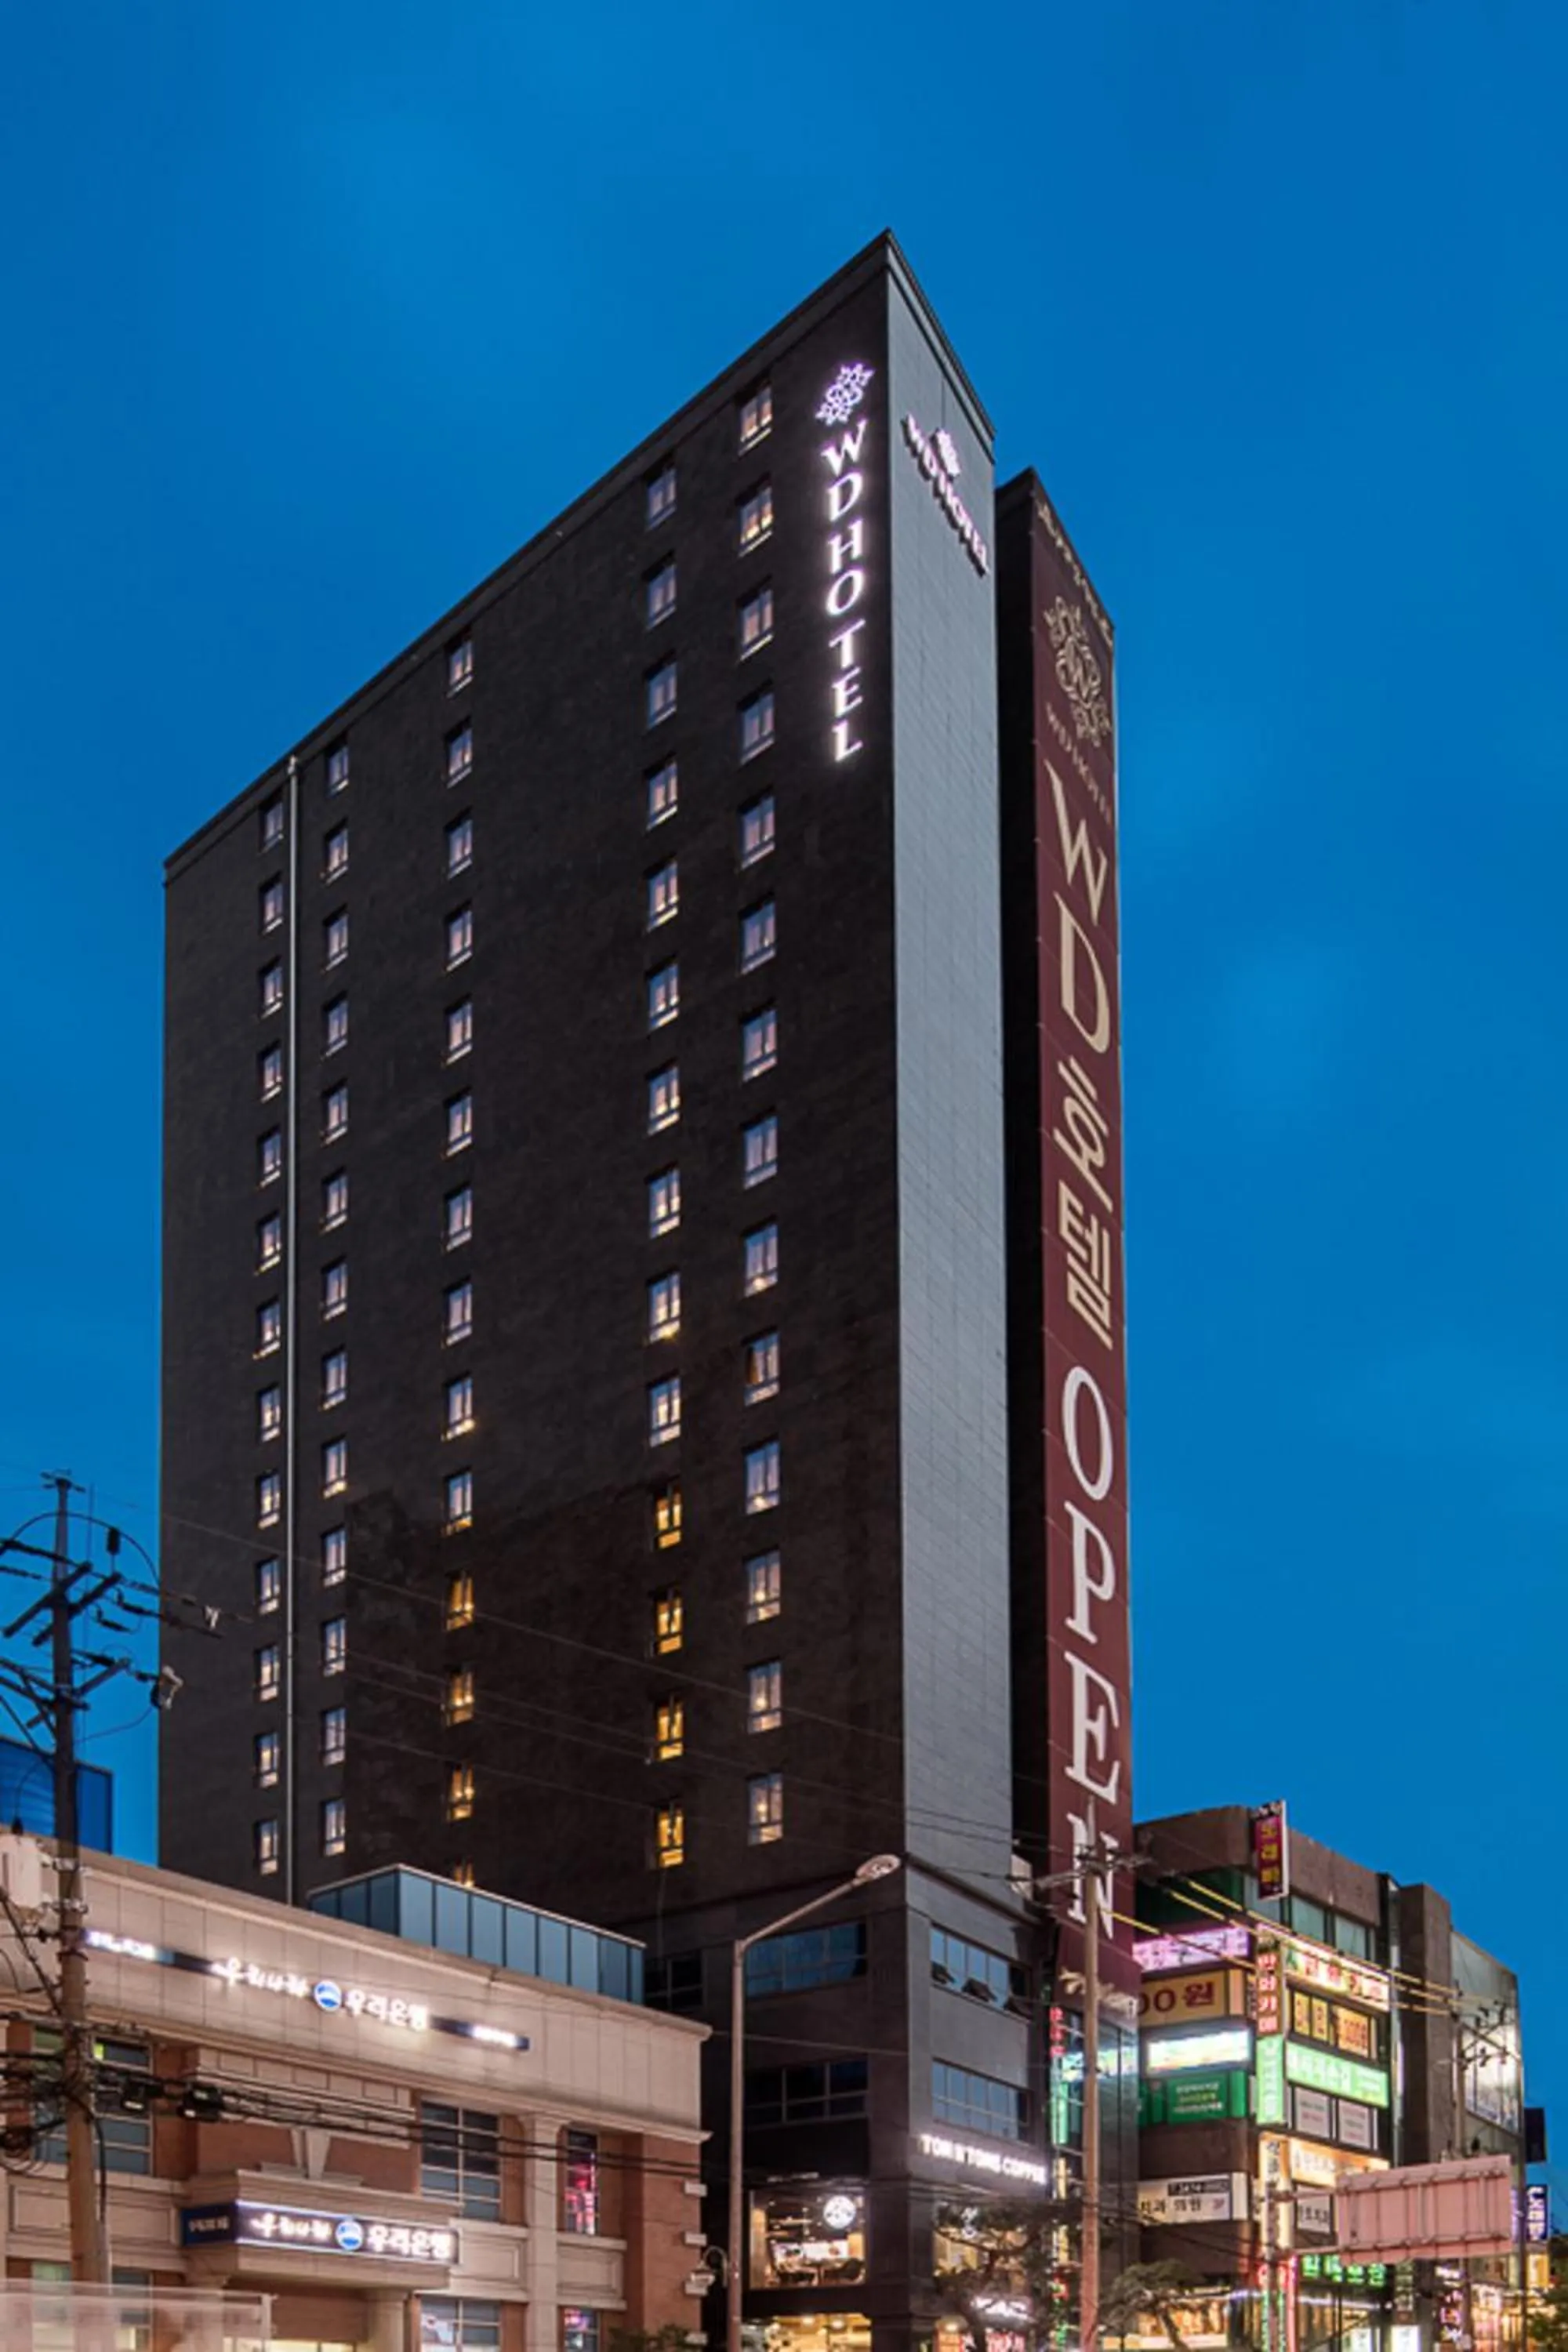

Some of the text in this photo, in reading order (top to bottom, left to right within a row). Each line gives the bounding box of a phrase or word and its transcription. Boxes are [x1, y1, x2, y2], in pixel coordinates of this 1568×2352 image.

[1062, 1365, 1120, 1940] OPEN
[346, 1988, 429, 2031] 우리은행
[366, 2223, 452, 2259] 우리은행
